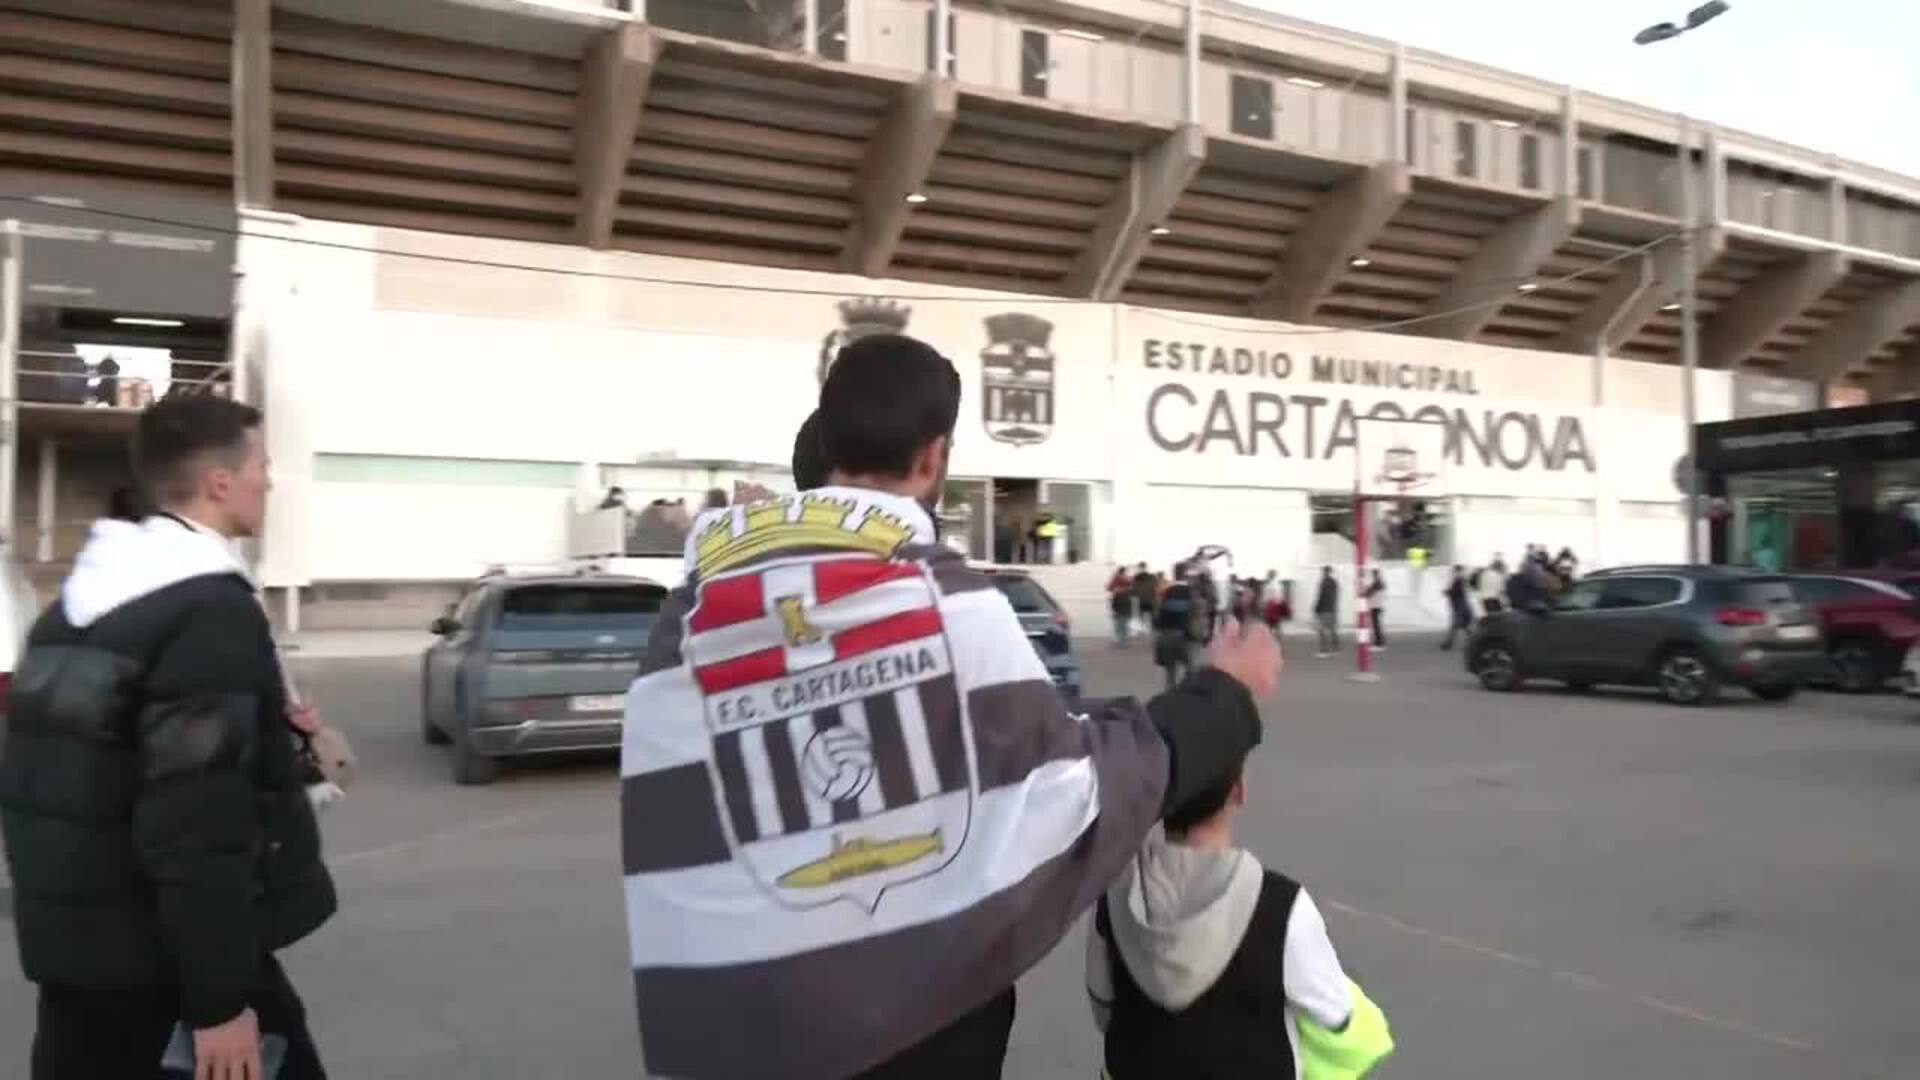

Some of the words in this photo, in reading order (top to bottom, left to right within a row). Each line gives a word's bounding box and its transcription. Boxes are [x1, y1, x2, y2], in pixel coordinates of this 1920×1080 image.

[1143, 339, 1293, 380] ESTADIO
[1311, 355, 1480, 395] MUNICIPAL
[1146, 383, 1597, 473] CARTANOVA
[772, 648, 936, 712] CARTAGENA
